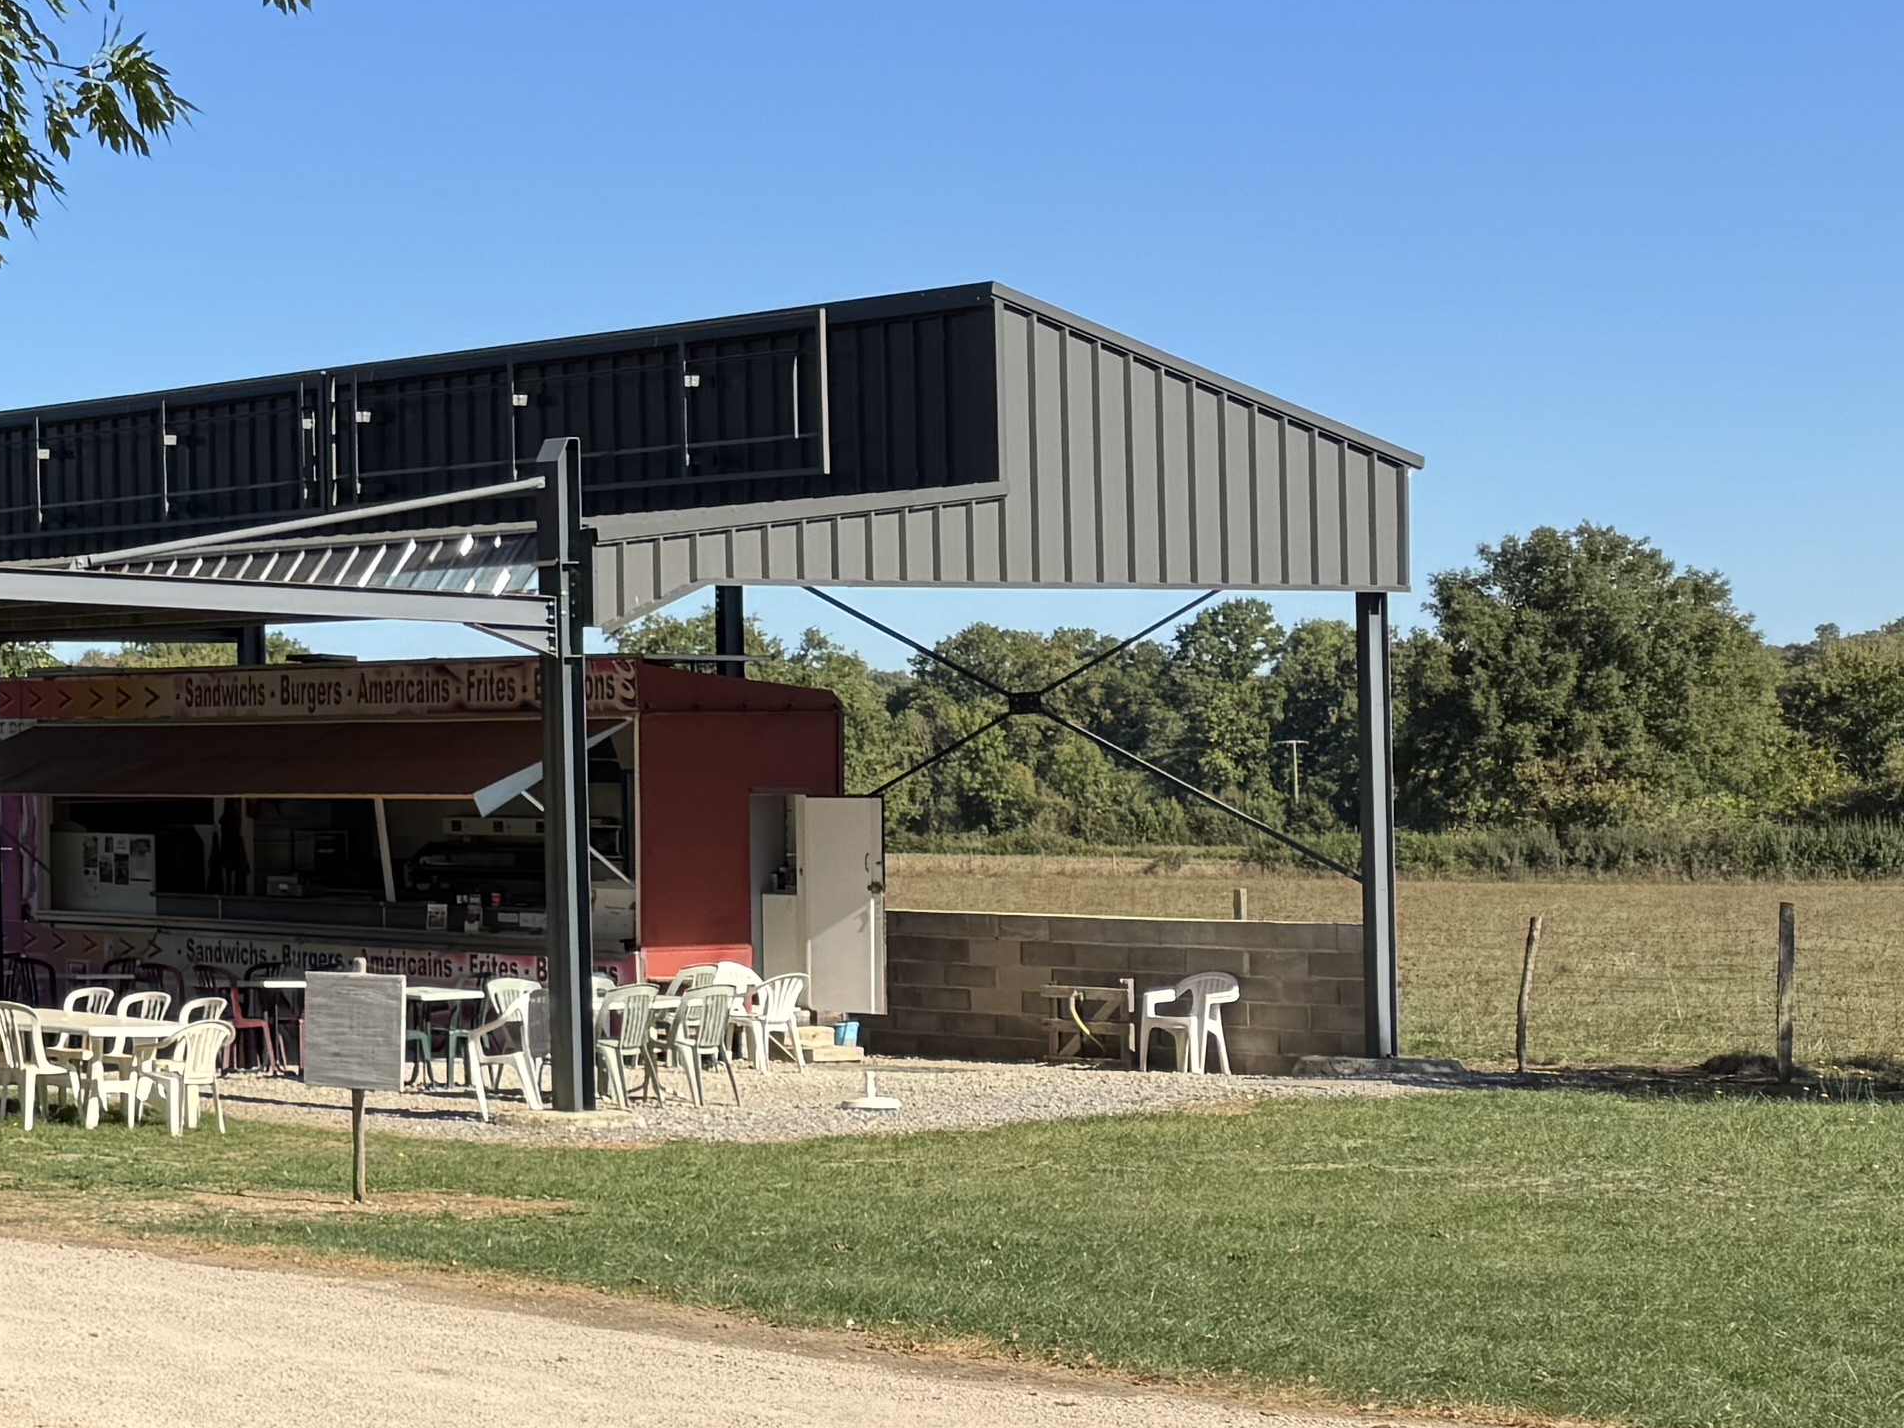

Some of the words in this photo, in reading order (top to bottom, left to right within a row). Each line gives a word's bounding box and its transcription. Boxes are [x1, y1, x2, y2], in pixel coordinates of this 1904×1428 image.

[184, 675, 266, 708] Sandwichs
[279, 672, 342, 713] Burgers
[466, 669, 516, 702] Frites
[186, 938, 267, 965] Sandwichs
[282, 943, 343, 972] Burgers
[468, 953, 519, 975] Frites
